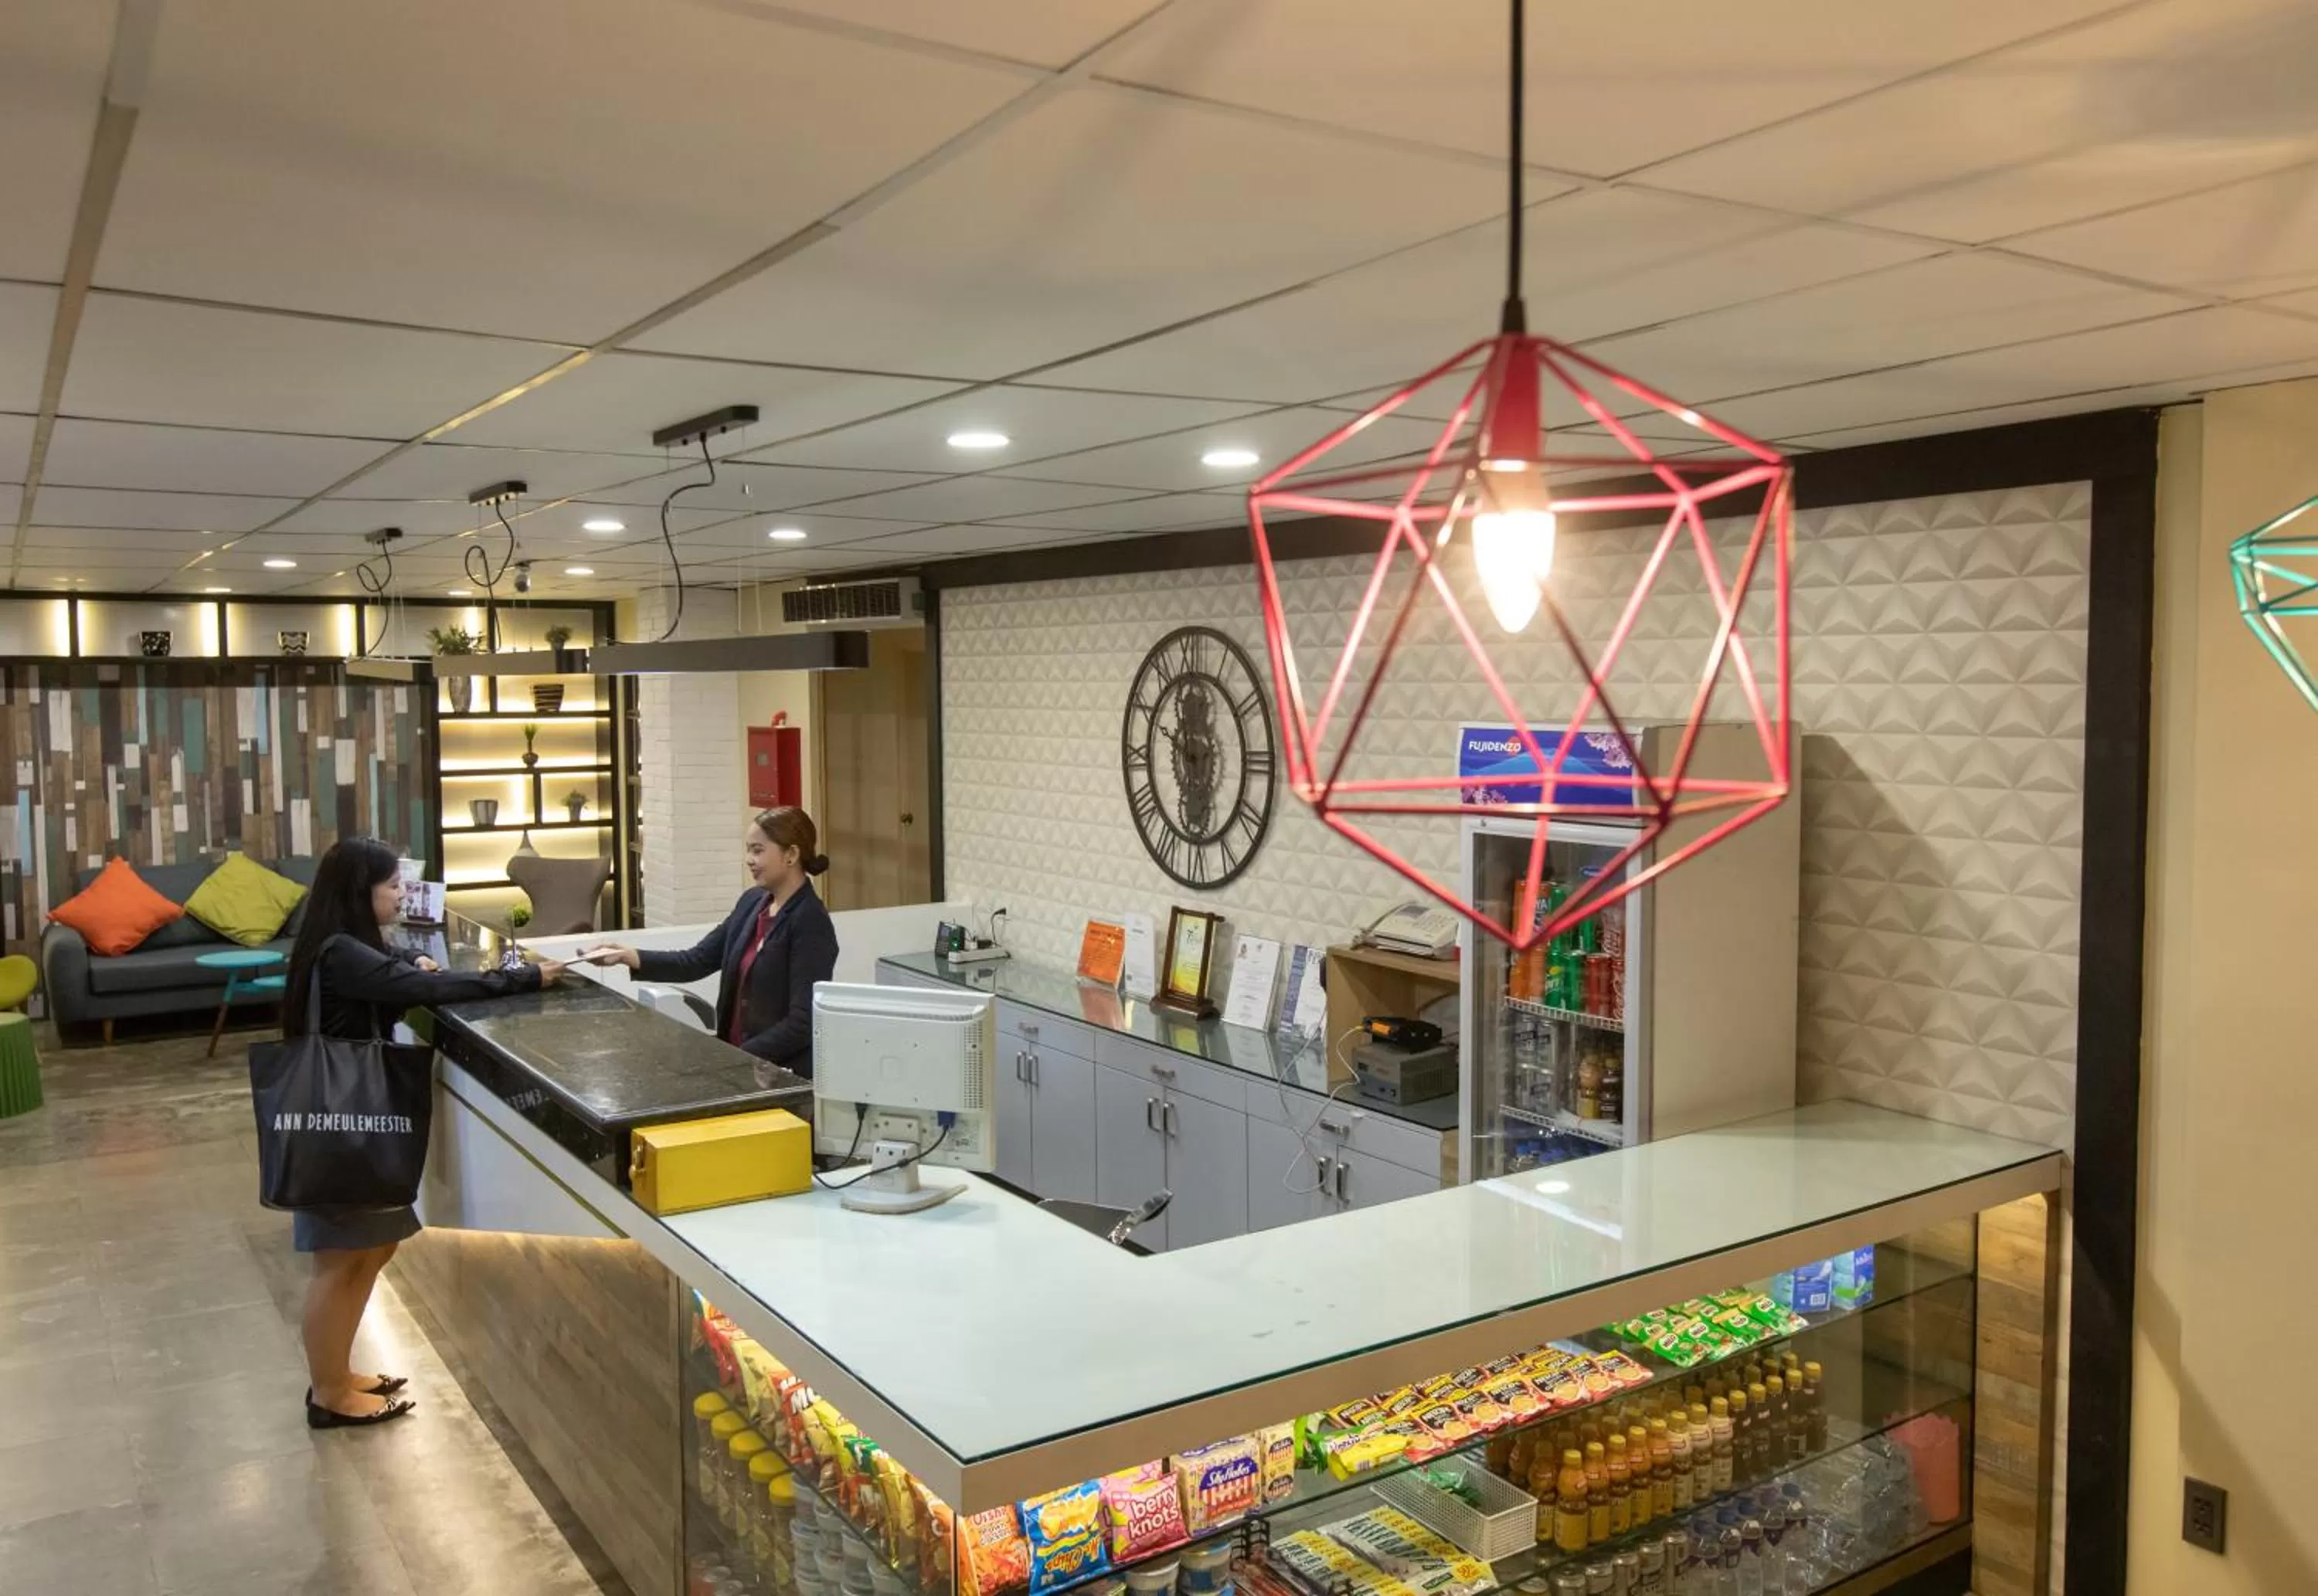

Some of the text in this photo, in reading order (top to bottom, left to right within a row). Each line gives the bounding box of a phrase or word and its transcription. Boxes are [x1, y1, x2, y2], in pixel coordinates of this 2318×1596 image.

[1469, 740, 1521, 753] FUJIDENZO
[274, 1112, 413, 1133] ANN DEMEULEMEESTER
[1129, 1506, 1179, 1539] knots
